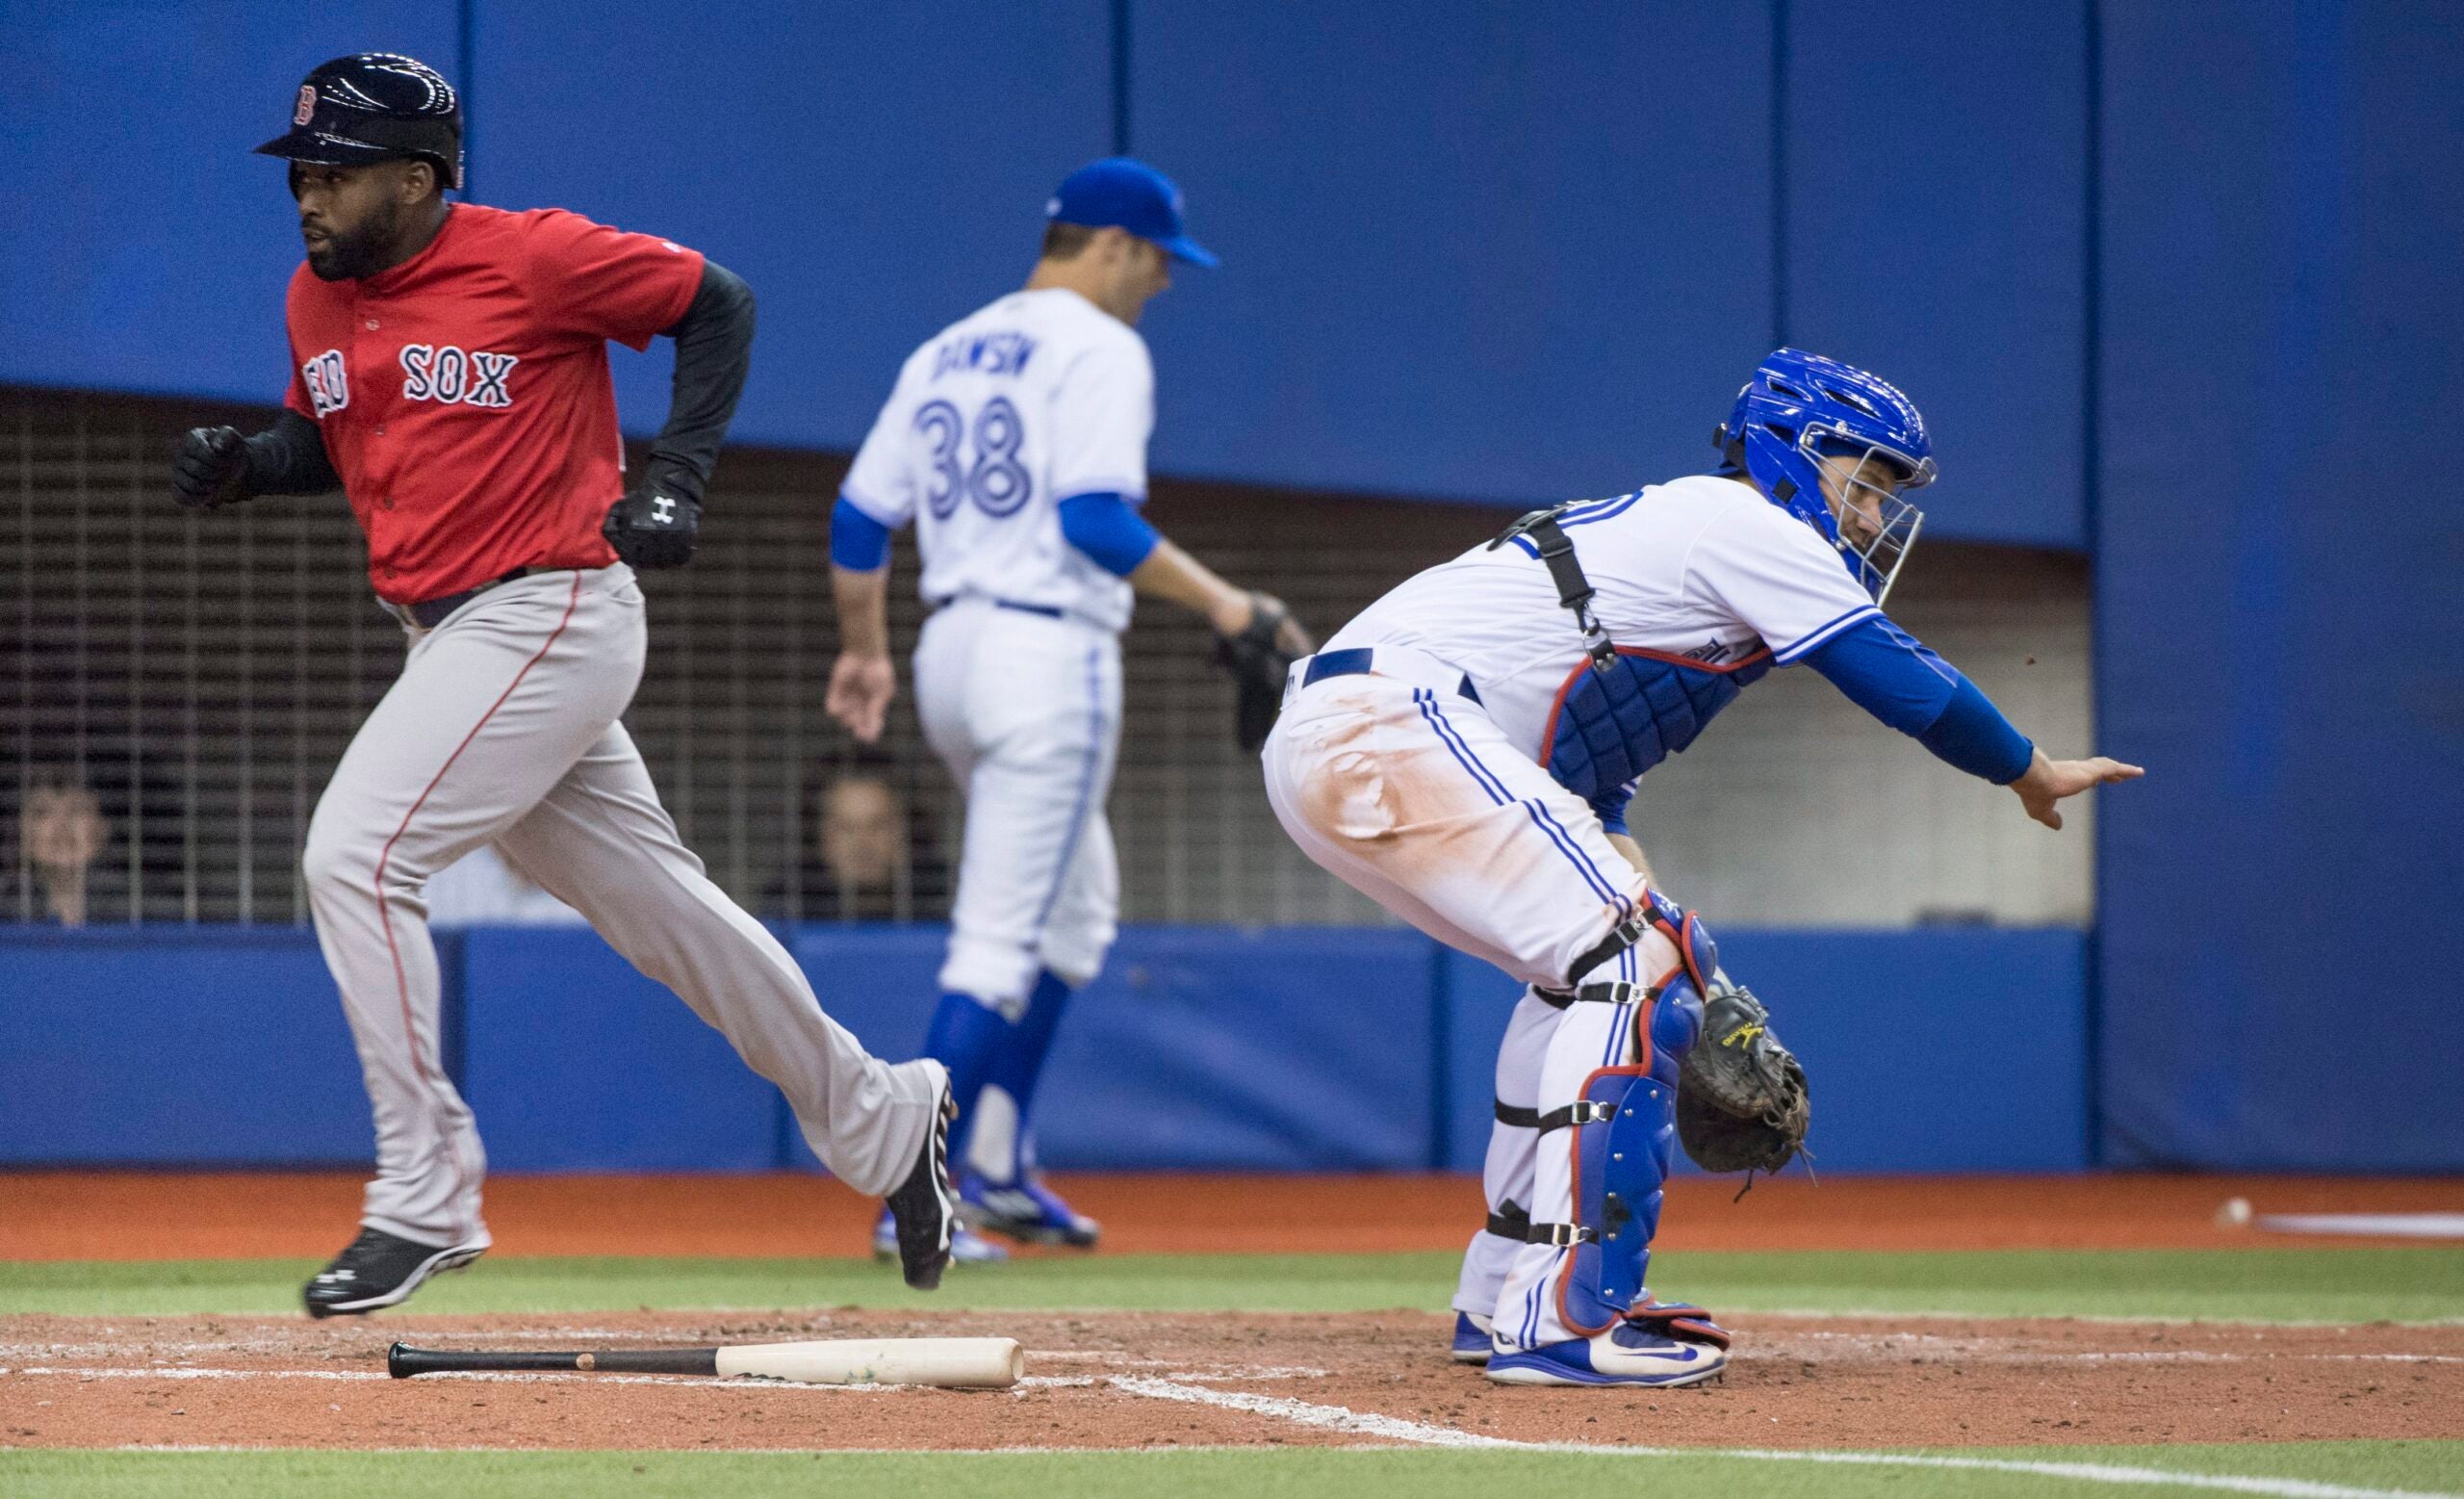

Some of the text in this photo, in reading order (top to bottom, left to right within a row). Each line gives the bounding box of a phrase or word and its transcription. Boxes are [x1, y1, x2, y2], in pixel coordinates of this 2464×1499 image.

[294, 85, 317, 126] B
[399, 344, 520, 407] SOX
[913, 397, 1032, 521] 38
